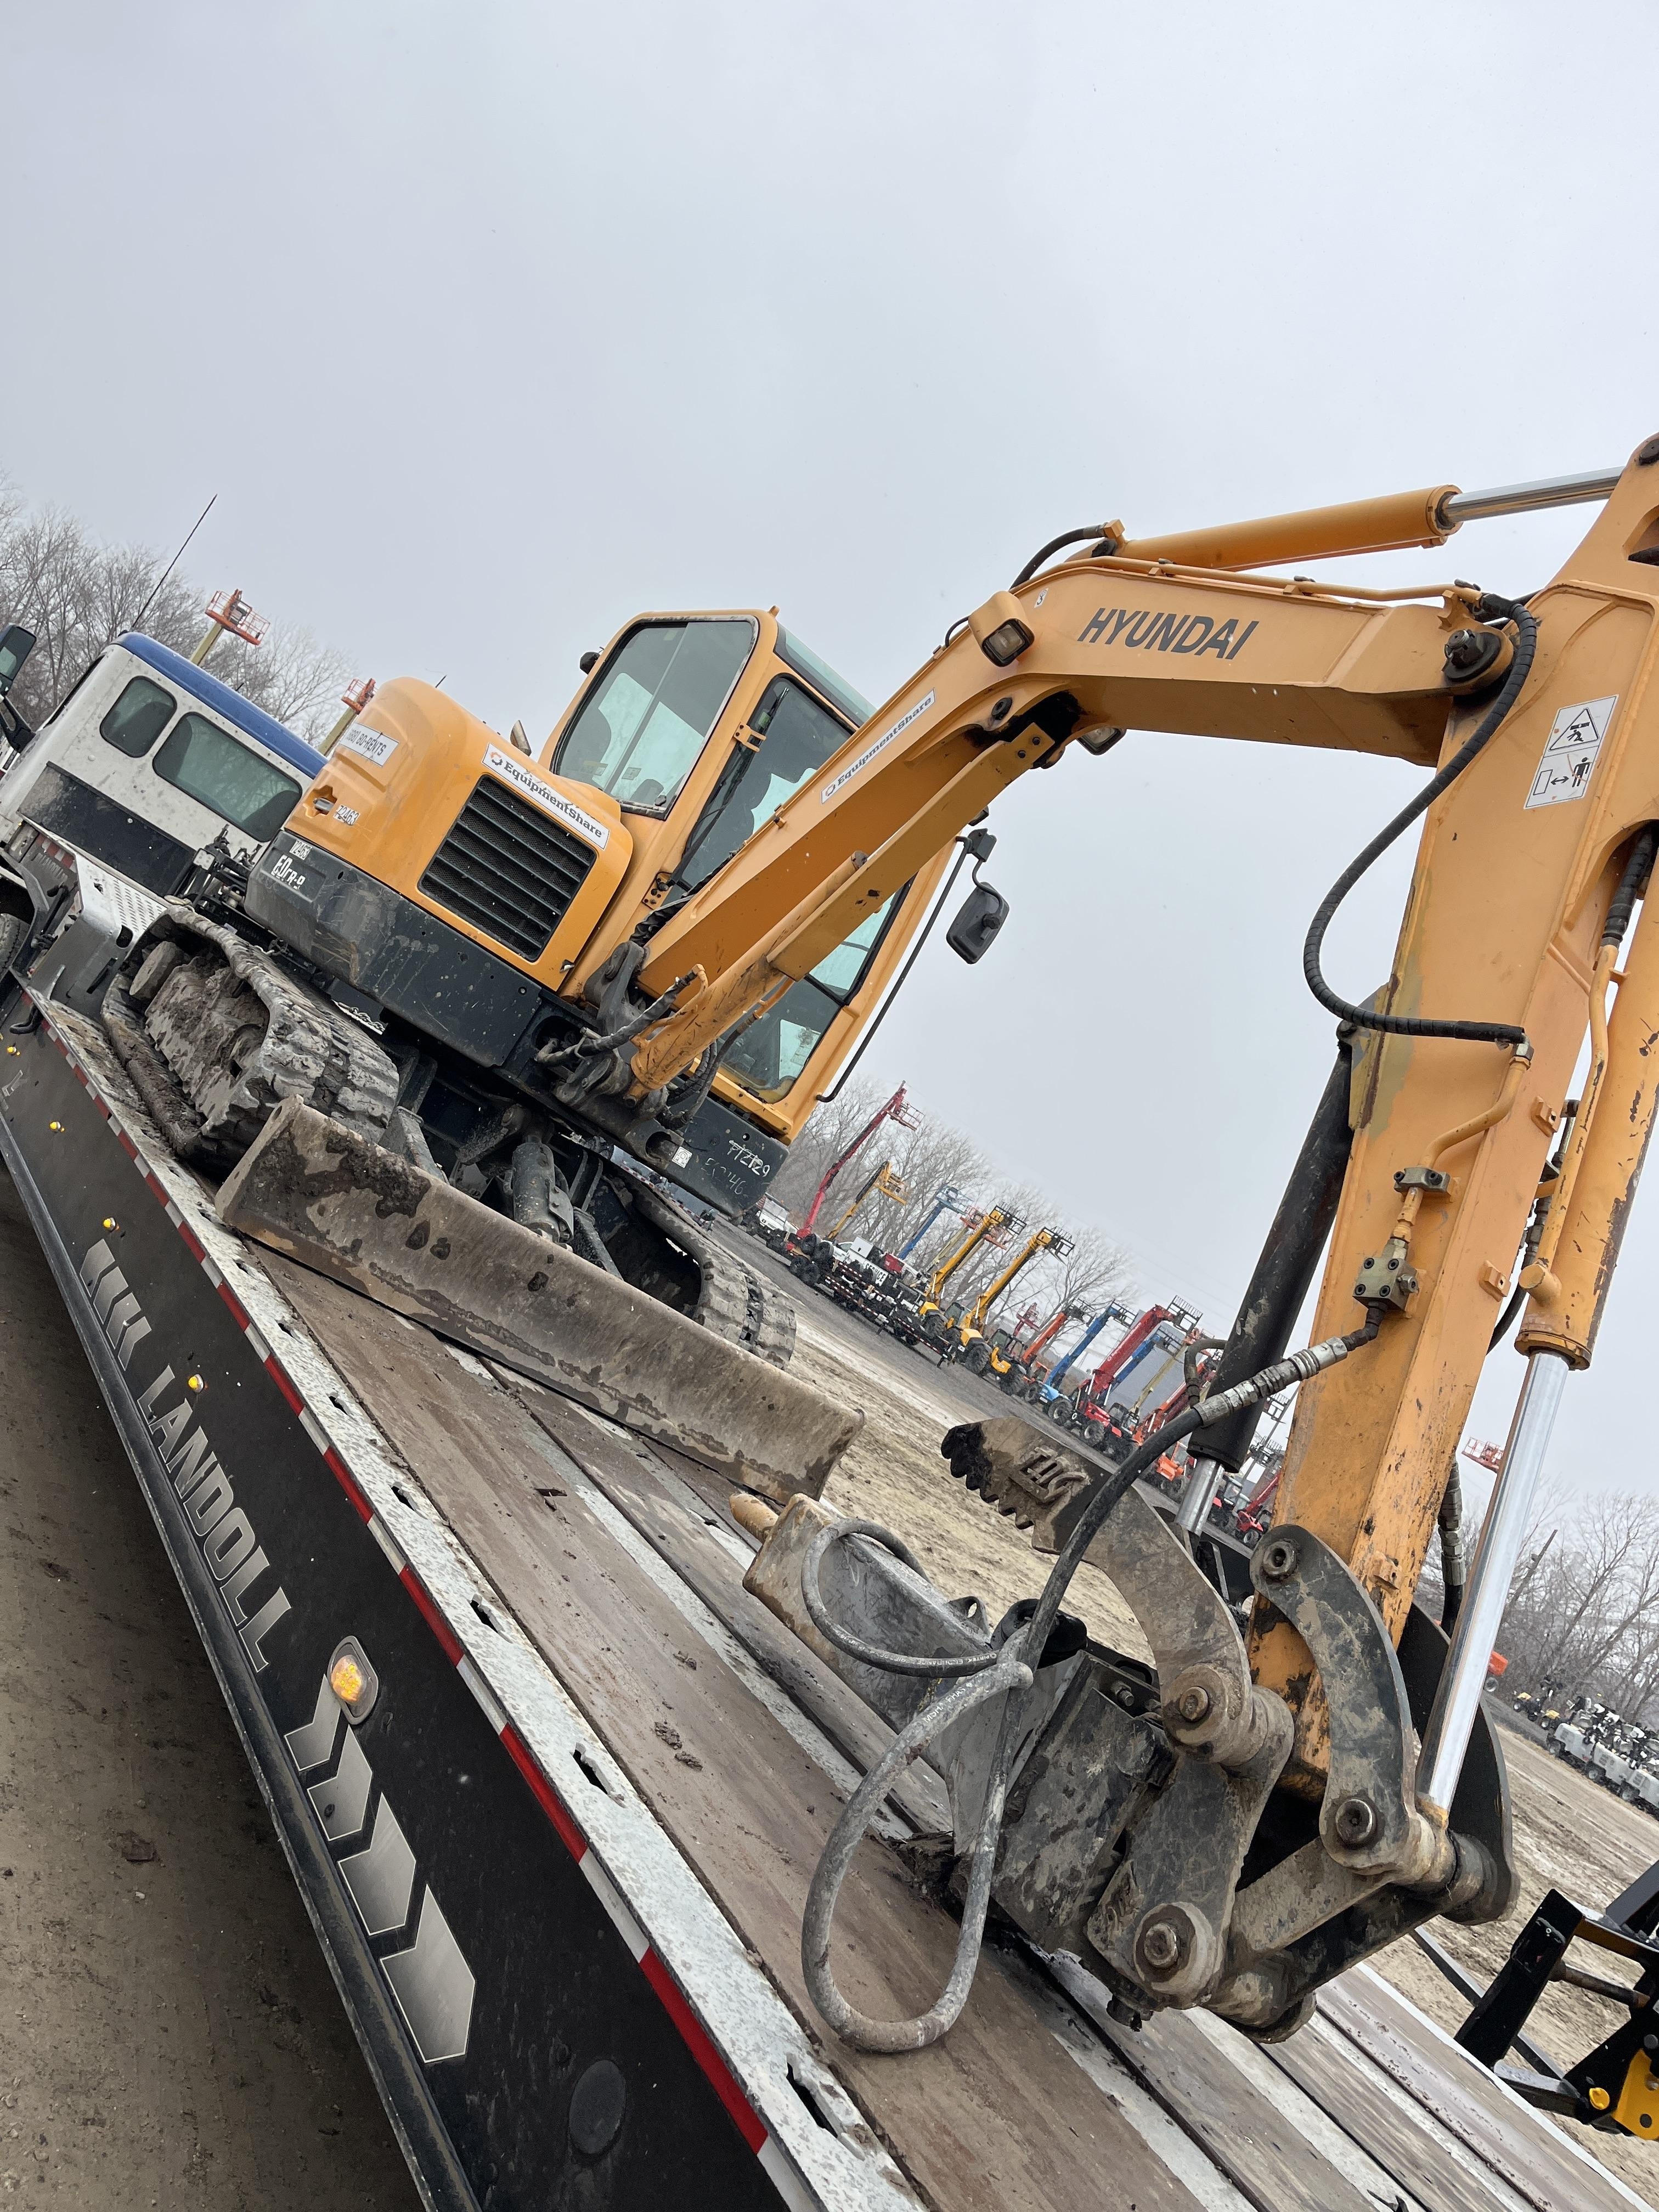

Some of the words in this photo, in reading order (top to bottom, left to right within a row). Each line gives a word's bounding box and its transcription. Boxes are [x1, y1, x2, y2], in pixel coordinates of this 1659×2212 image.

[1077, 607, 1260, 660] HYUNDAI
[837, 697, 931, 787] EquipmentShare
[504, 760, 602, 838] EquipmentShare
[137, 1364, 292, 1673] LANDOLL
